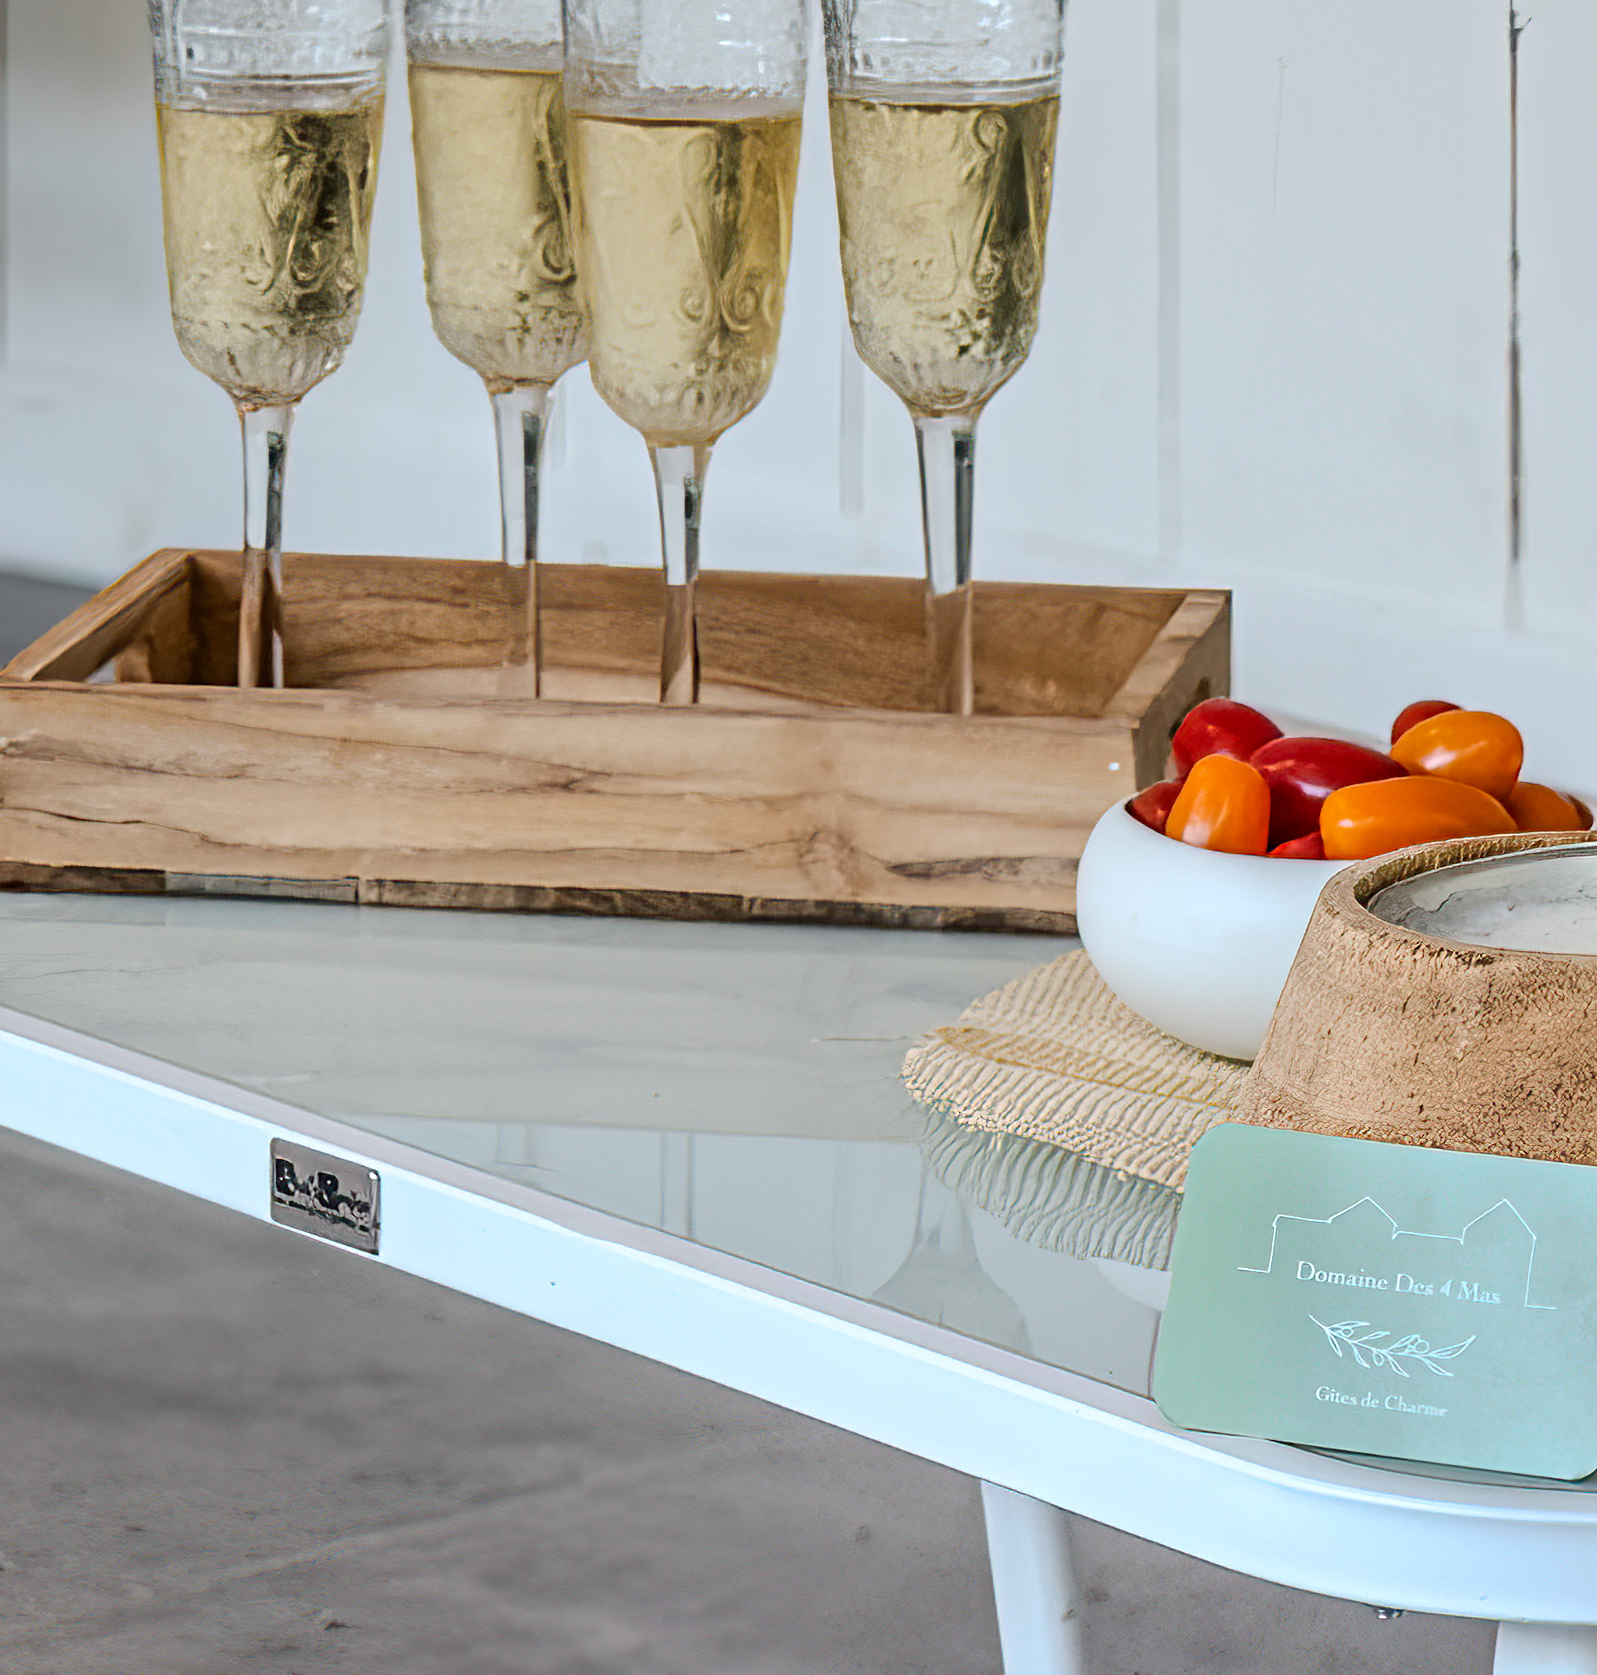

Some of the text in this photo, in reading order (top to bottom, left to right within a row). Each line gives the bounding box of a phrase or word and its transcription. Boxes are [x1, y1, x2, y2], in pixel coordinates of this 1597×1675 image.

[1295, 1260, 1502, 1305] Domaine Des 4 Mas
[1315, 1385, 1449, 1417] Gîtes de Charme
